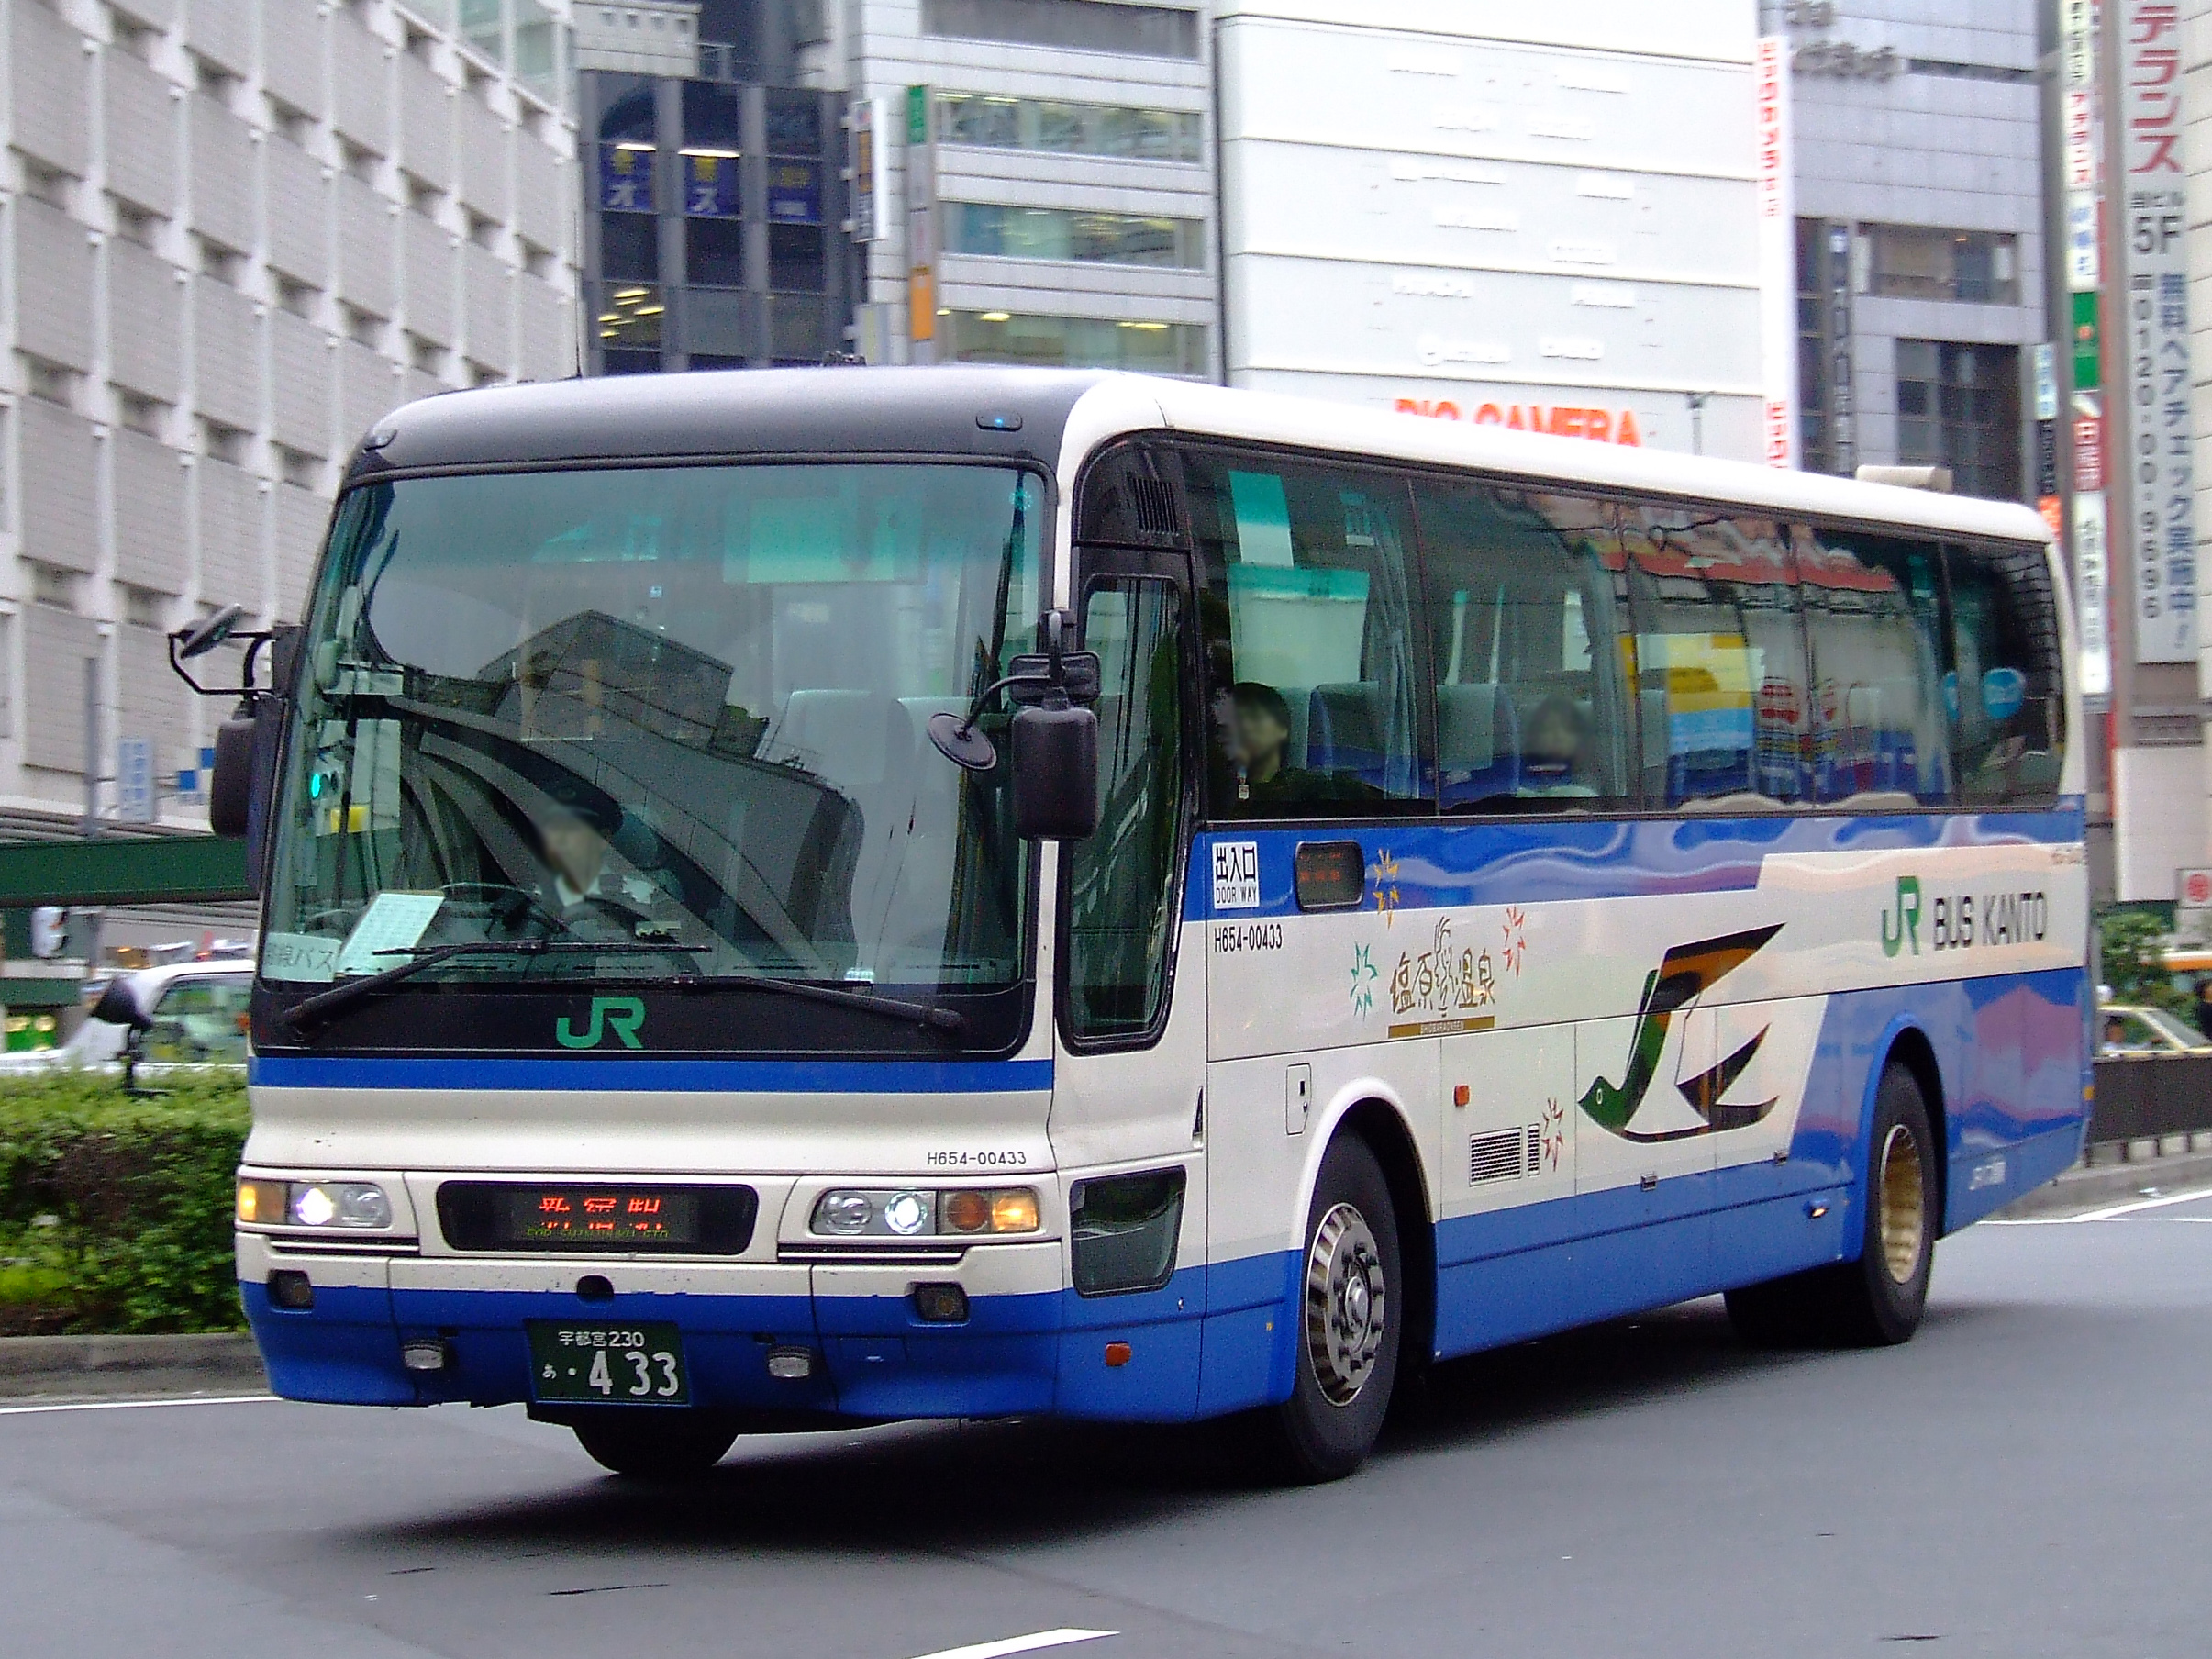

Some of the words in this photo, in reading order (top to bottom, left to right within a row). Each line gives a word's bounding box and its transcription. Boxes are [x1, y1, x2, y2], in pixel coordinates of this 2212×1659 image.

[2132, 214, 2182, 254] 5F
[1216, 846, 1257, 883] 出入口
[1216, 886, 1237, 904] DOOR
[1240, 885, 1257, 902] WAY
[1882, 876, 1919, 957] JR
[1935, 895, 1973, 951] BUS
[1983, 891, 2048, 946] KANTO
[1214, 923, 1283, 953] H654-00433
[556, 997, 646, 1049] JR
[927, 1151, 1027, 1165] H654-00433
